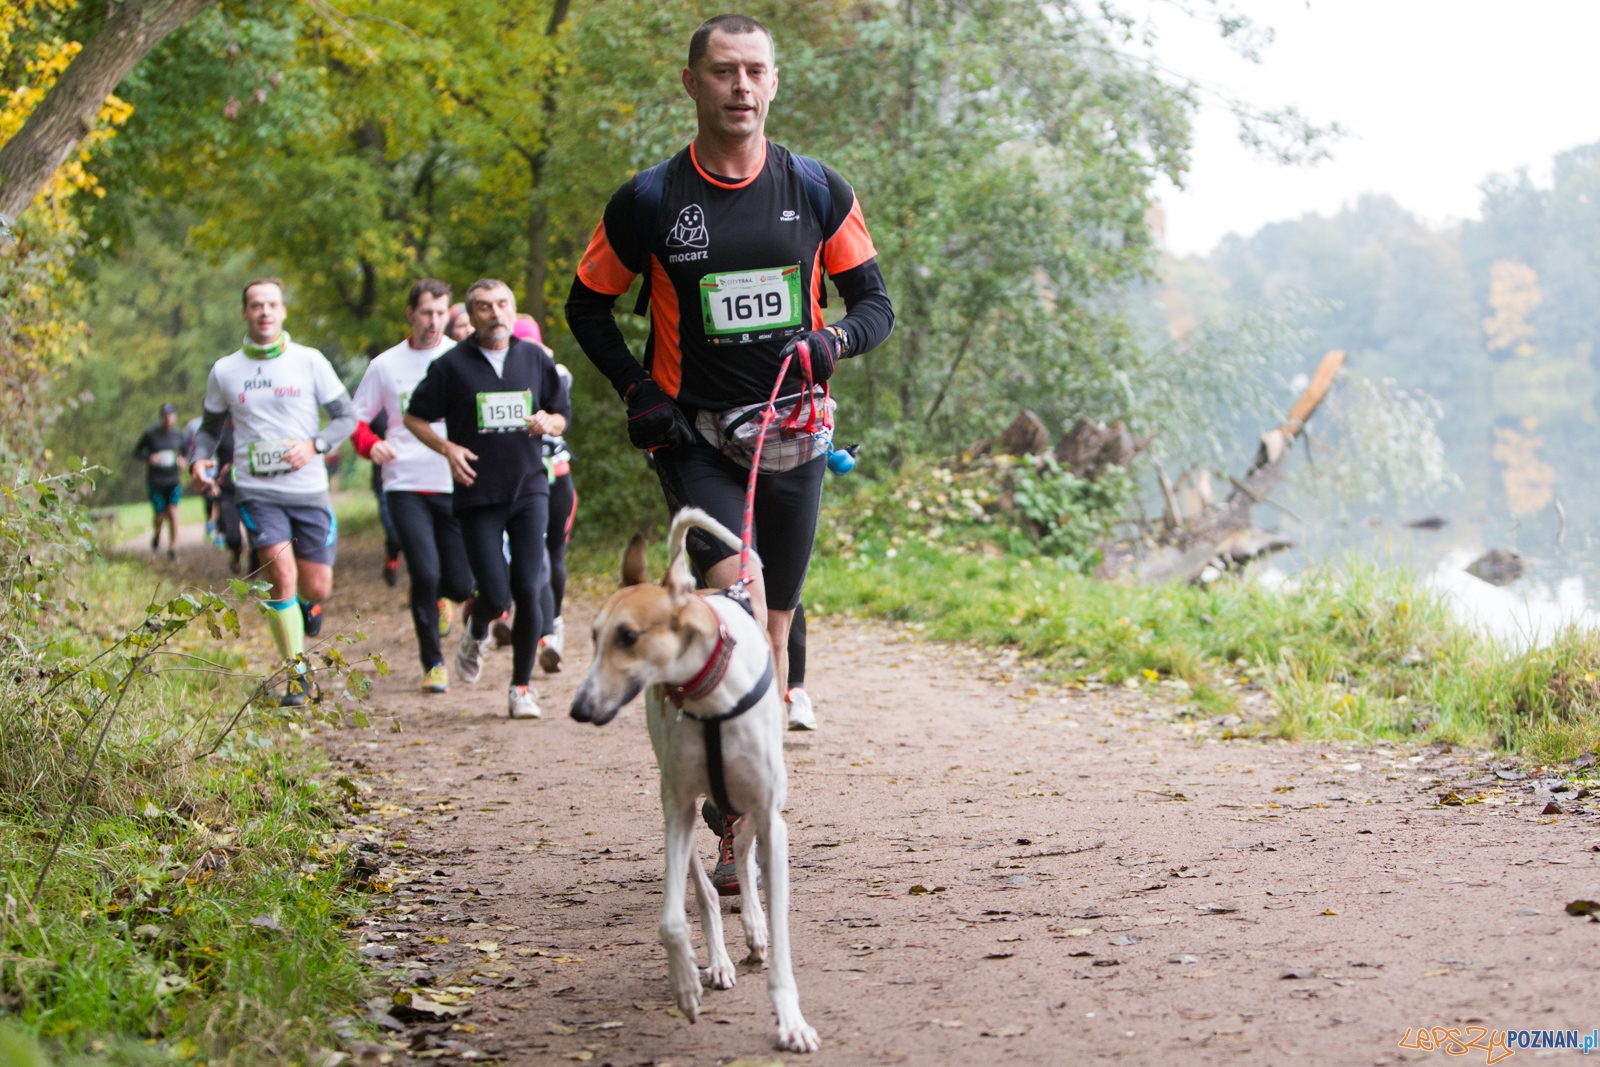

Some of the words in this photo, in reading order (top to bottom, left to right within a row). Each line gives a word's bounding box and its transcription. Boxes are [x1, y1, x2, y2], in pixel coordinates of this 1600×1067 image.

[669, 250, 709, 263] mocarz
[722, 291, 782, 321] 1619
[244, 378, 272, 392] RUN
[488, 404, 523, 420] 1518
[255, 449, 291, 466] 109
